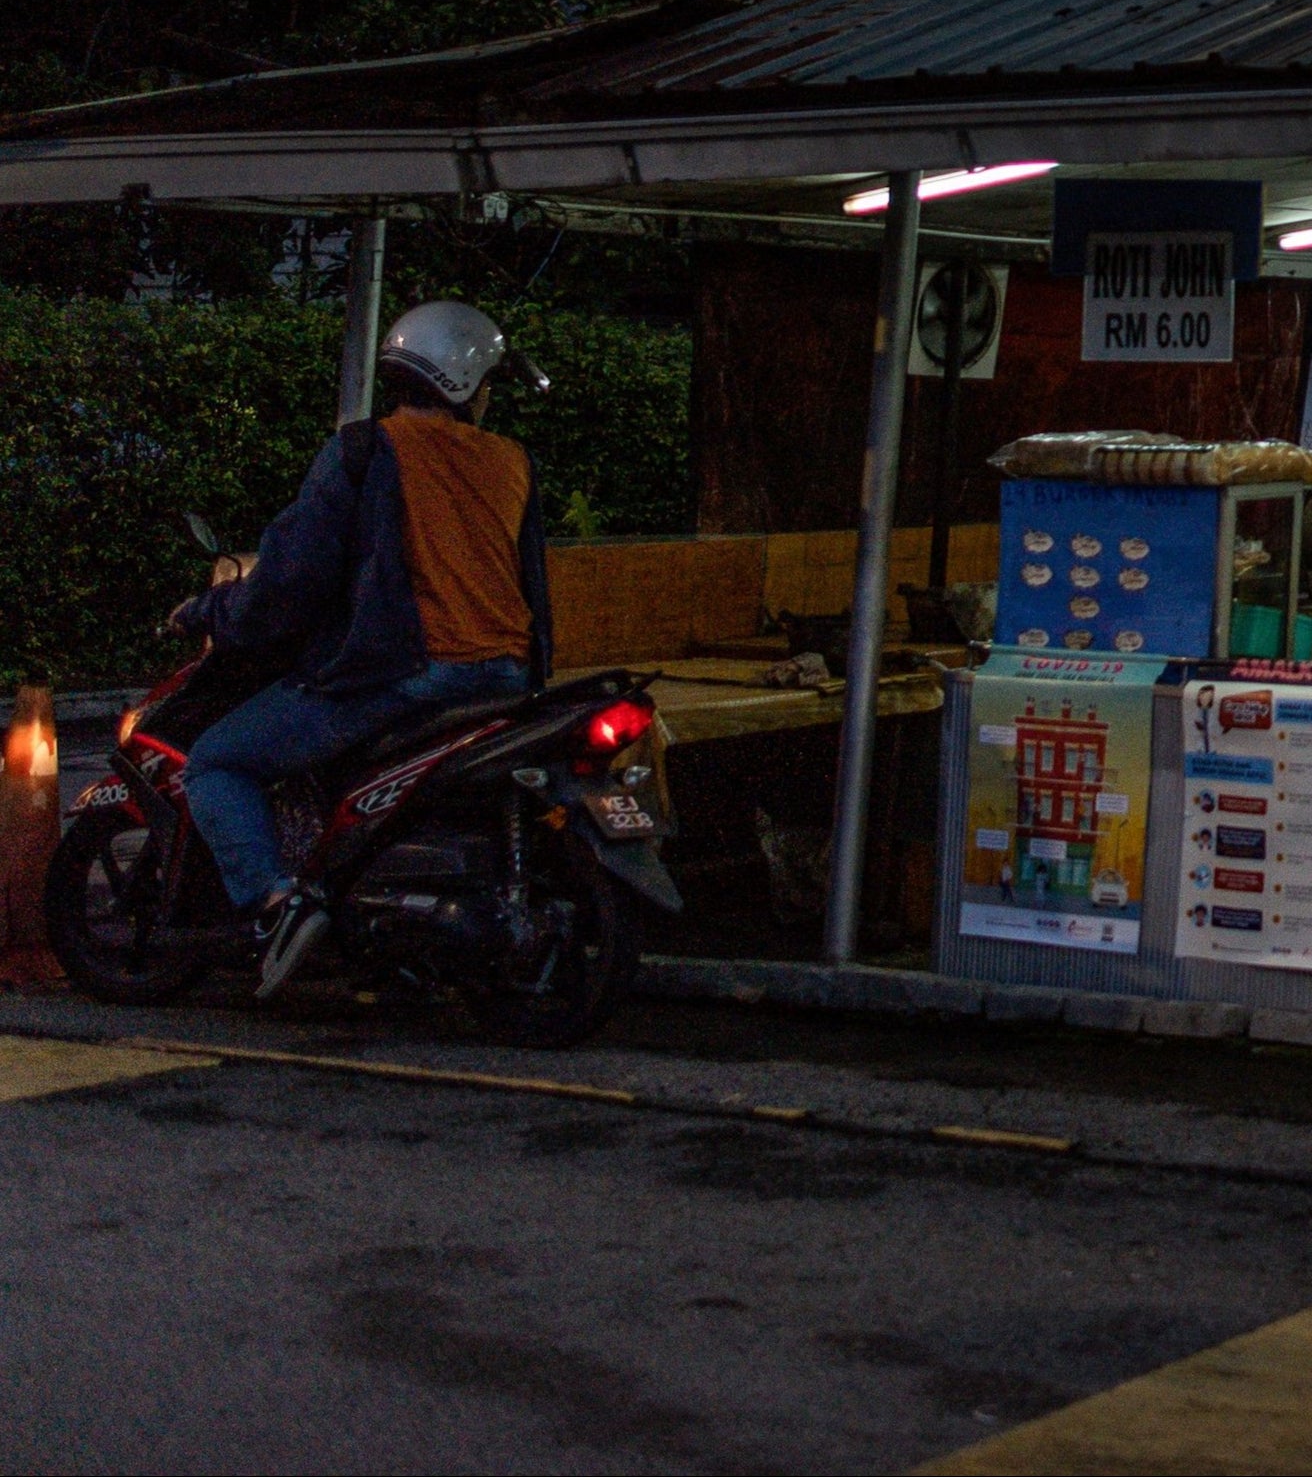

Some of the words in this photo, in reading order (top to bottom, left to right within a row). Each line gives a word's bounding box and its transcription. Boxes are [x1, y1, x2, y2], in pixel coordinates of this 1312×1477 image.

[1093, 243, 1151, 299] ROTI
[1160, 242, 1226, 298] JOHN
[1104, 312, 1147, 349] RM
[1156, 311, 1211, 349] 6.00
